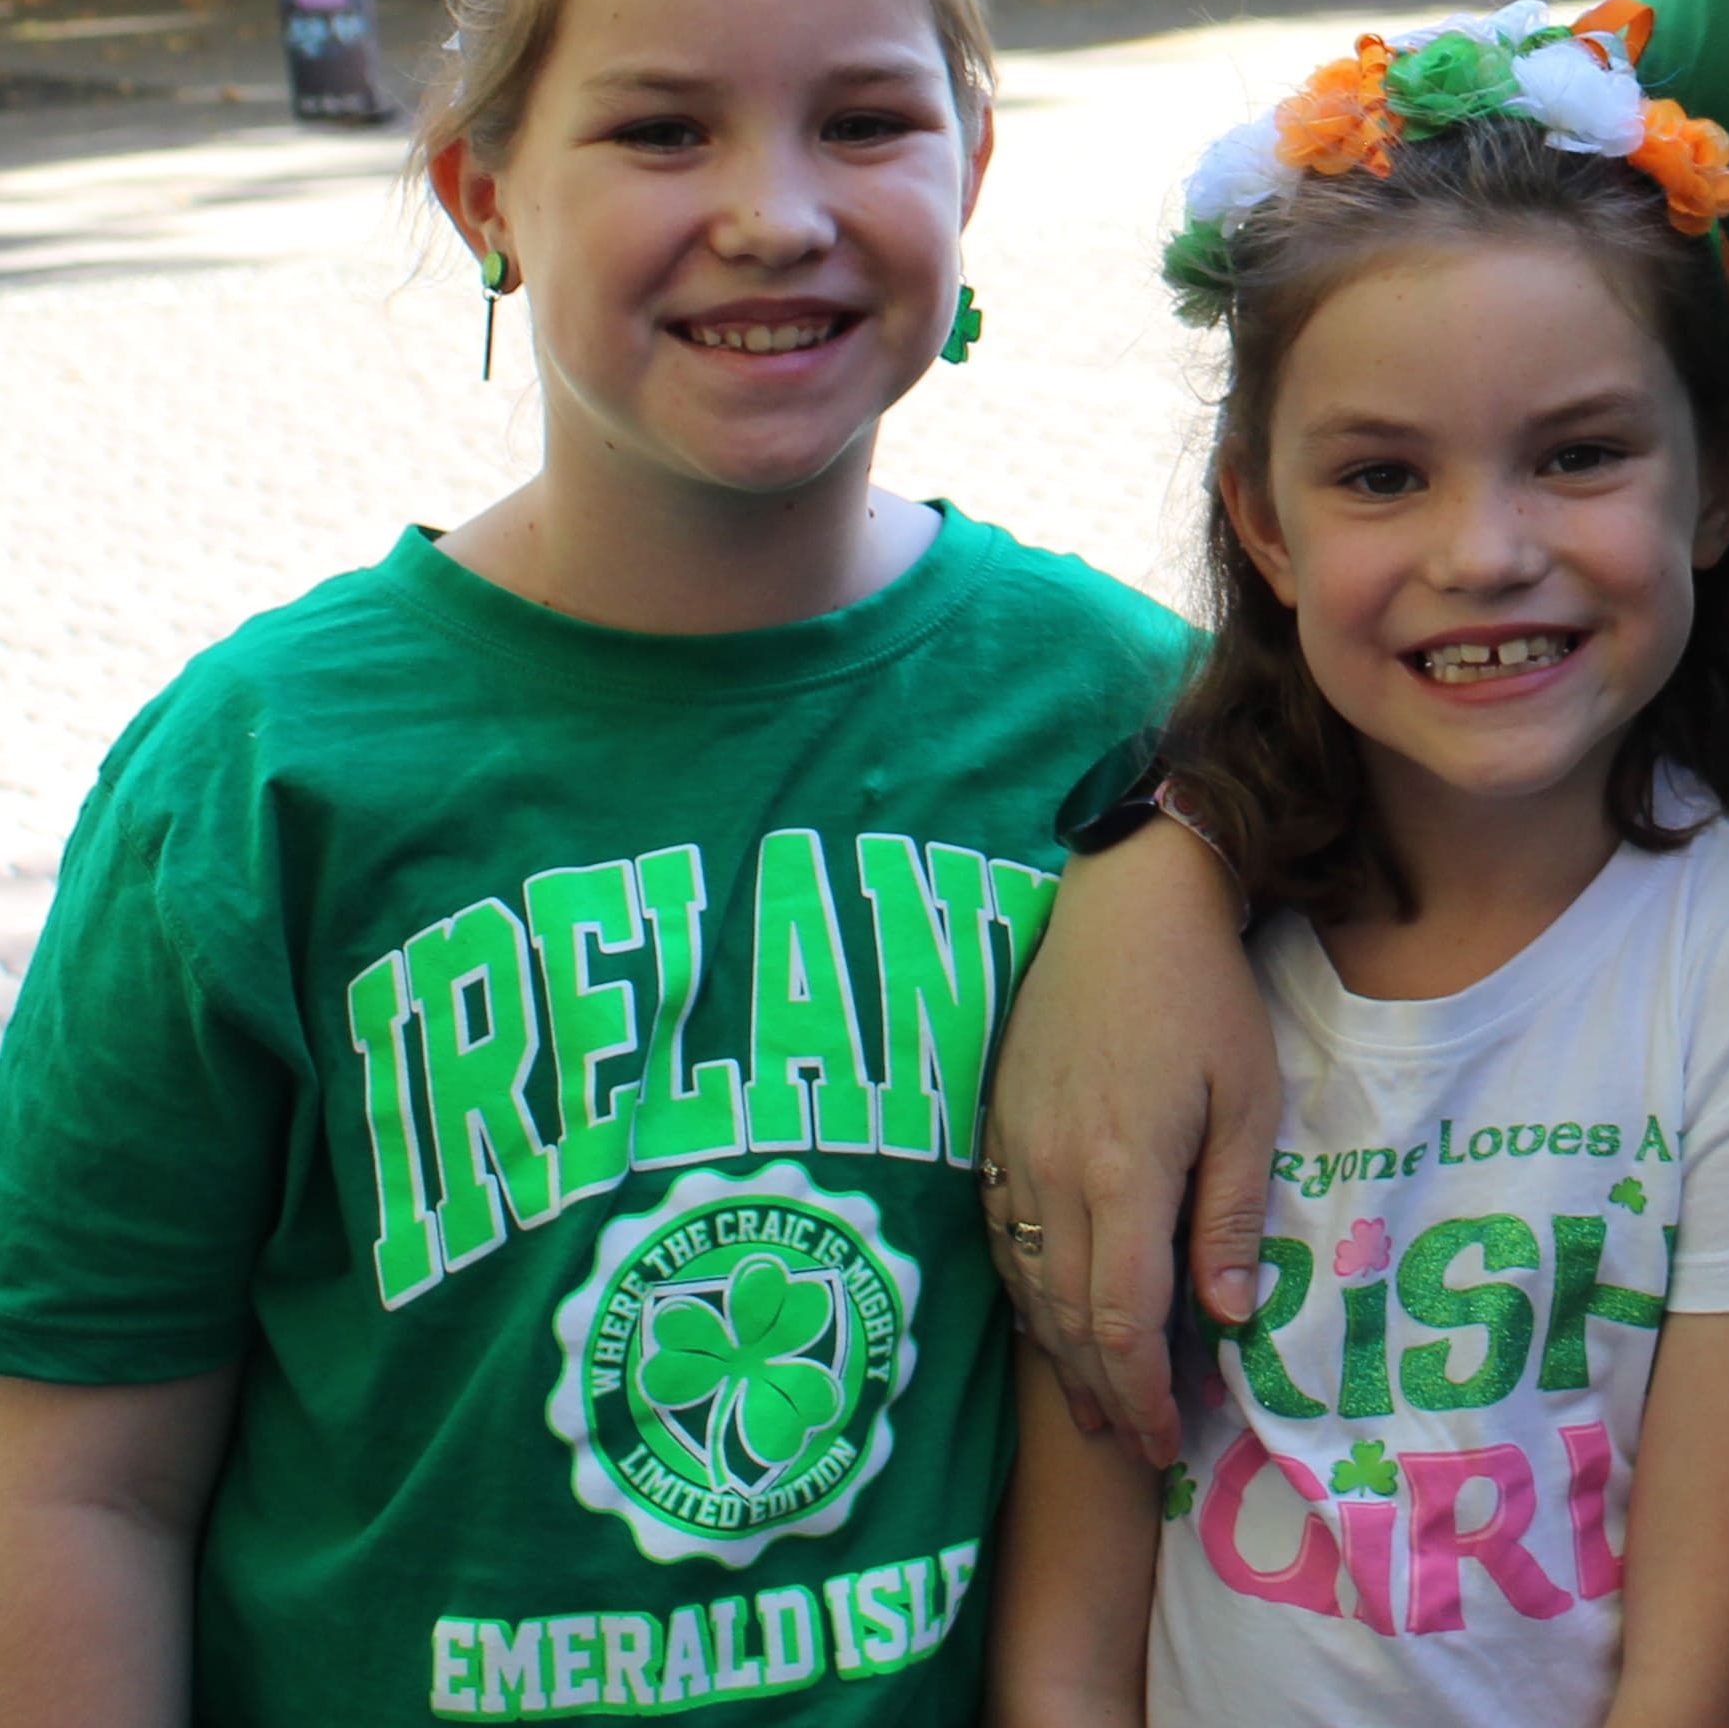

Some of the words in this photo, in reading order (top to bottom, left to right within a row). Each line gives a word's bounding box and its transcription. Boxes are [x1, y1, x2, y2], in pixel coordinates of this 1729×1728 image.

[348, 828, 1060, 1311] IRELAN
[1438, 1118, 1621, 1165] Loves
[591, 1273, 654, 1398] WHERE
[642, 1219, 712, 1280] THE
[714, 1209, 817, 1246] CRAIC
[813, 1227, 850, 1269] IS
[841, 1256, 895, 1383] MIGHTY
[1195, 1213, 1677, 1420] RiSH
[617, 1443, 742, 1529] LIMITED
[749, 1436, 858, 1525] EDITION
[430, 1584, 825, 1722] EMERALD
